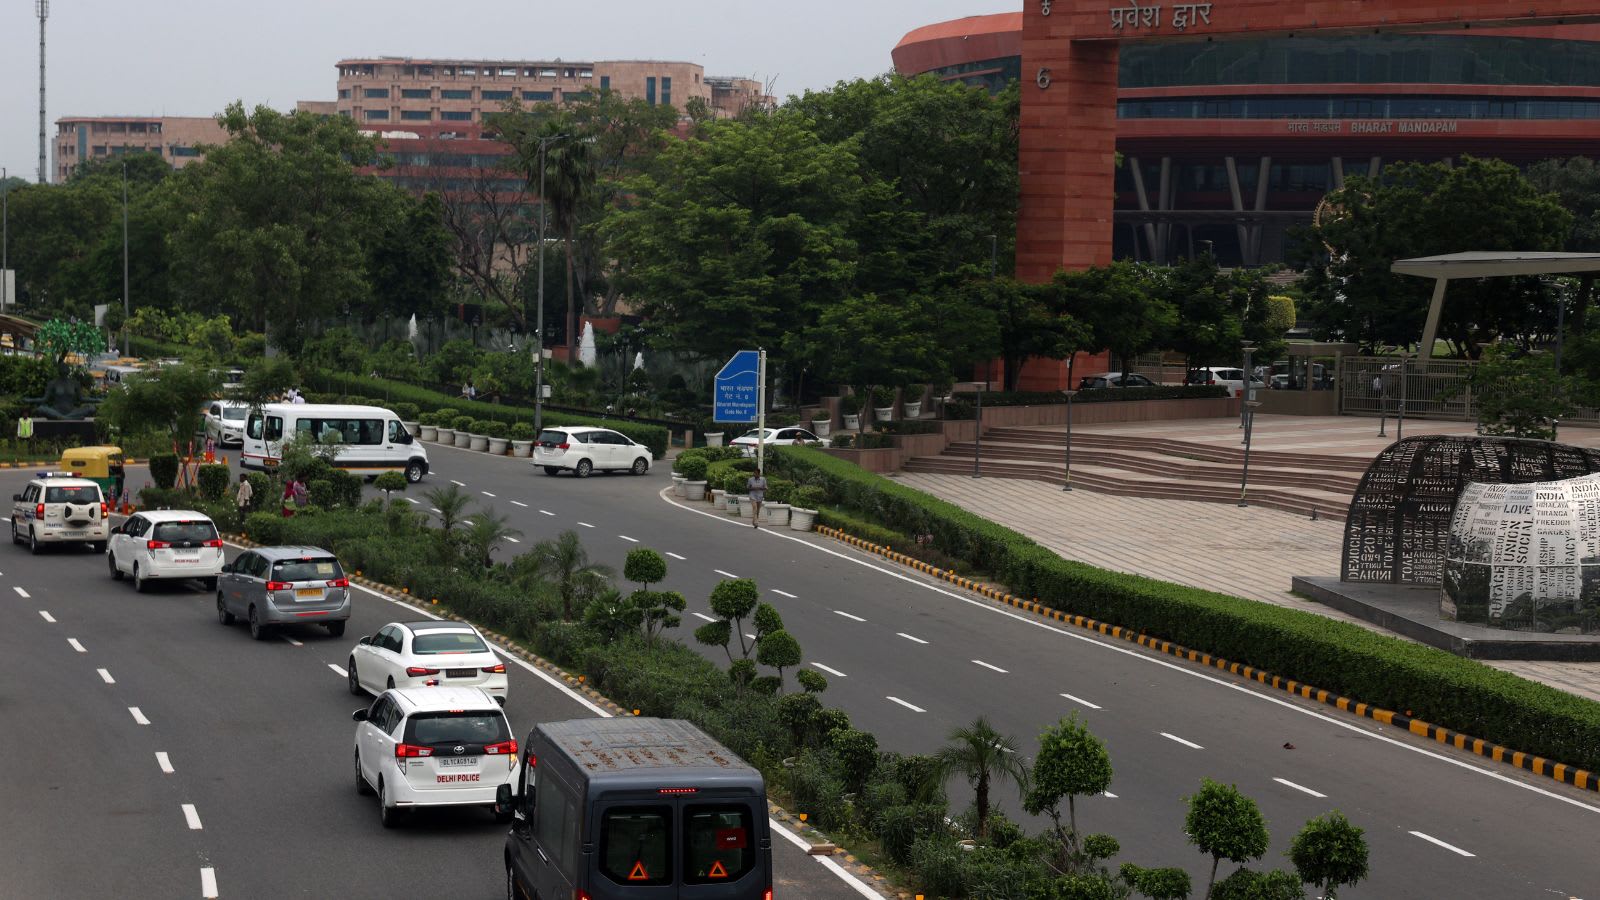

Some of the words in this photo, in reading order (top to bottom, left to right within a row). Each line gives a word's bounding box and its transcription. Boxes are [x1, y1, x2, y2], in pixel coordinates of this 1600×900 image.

[1111, 1, 1161, 29] प्रवेश
[1173, 3, 1212, 31] द्वार
[1037, 68, 1050, 88] 6
[1351, 122, 1393, 132] BHARAT
[1398, 121, 1457, 132] MANDAPAM
[1536, 492, 1565, 500] INDIA
[1571, 484, 1600, 493] INDIA
[1503, 503, 1533, 515] LOVE
[1503, 520, 1521, 562] UNION
[1516, 516, 1534, 564] SOCIAL
[1565, 535, 1576, 598] EMOCRACY
[437, 775, 456, 783] DELHI
[457, 774, 480, 782] POLICE
